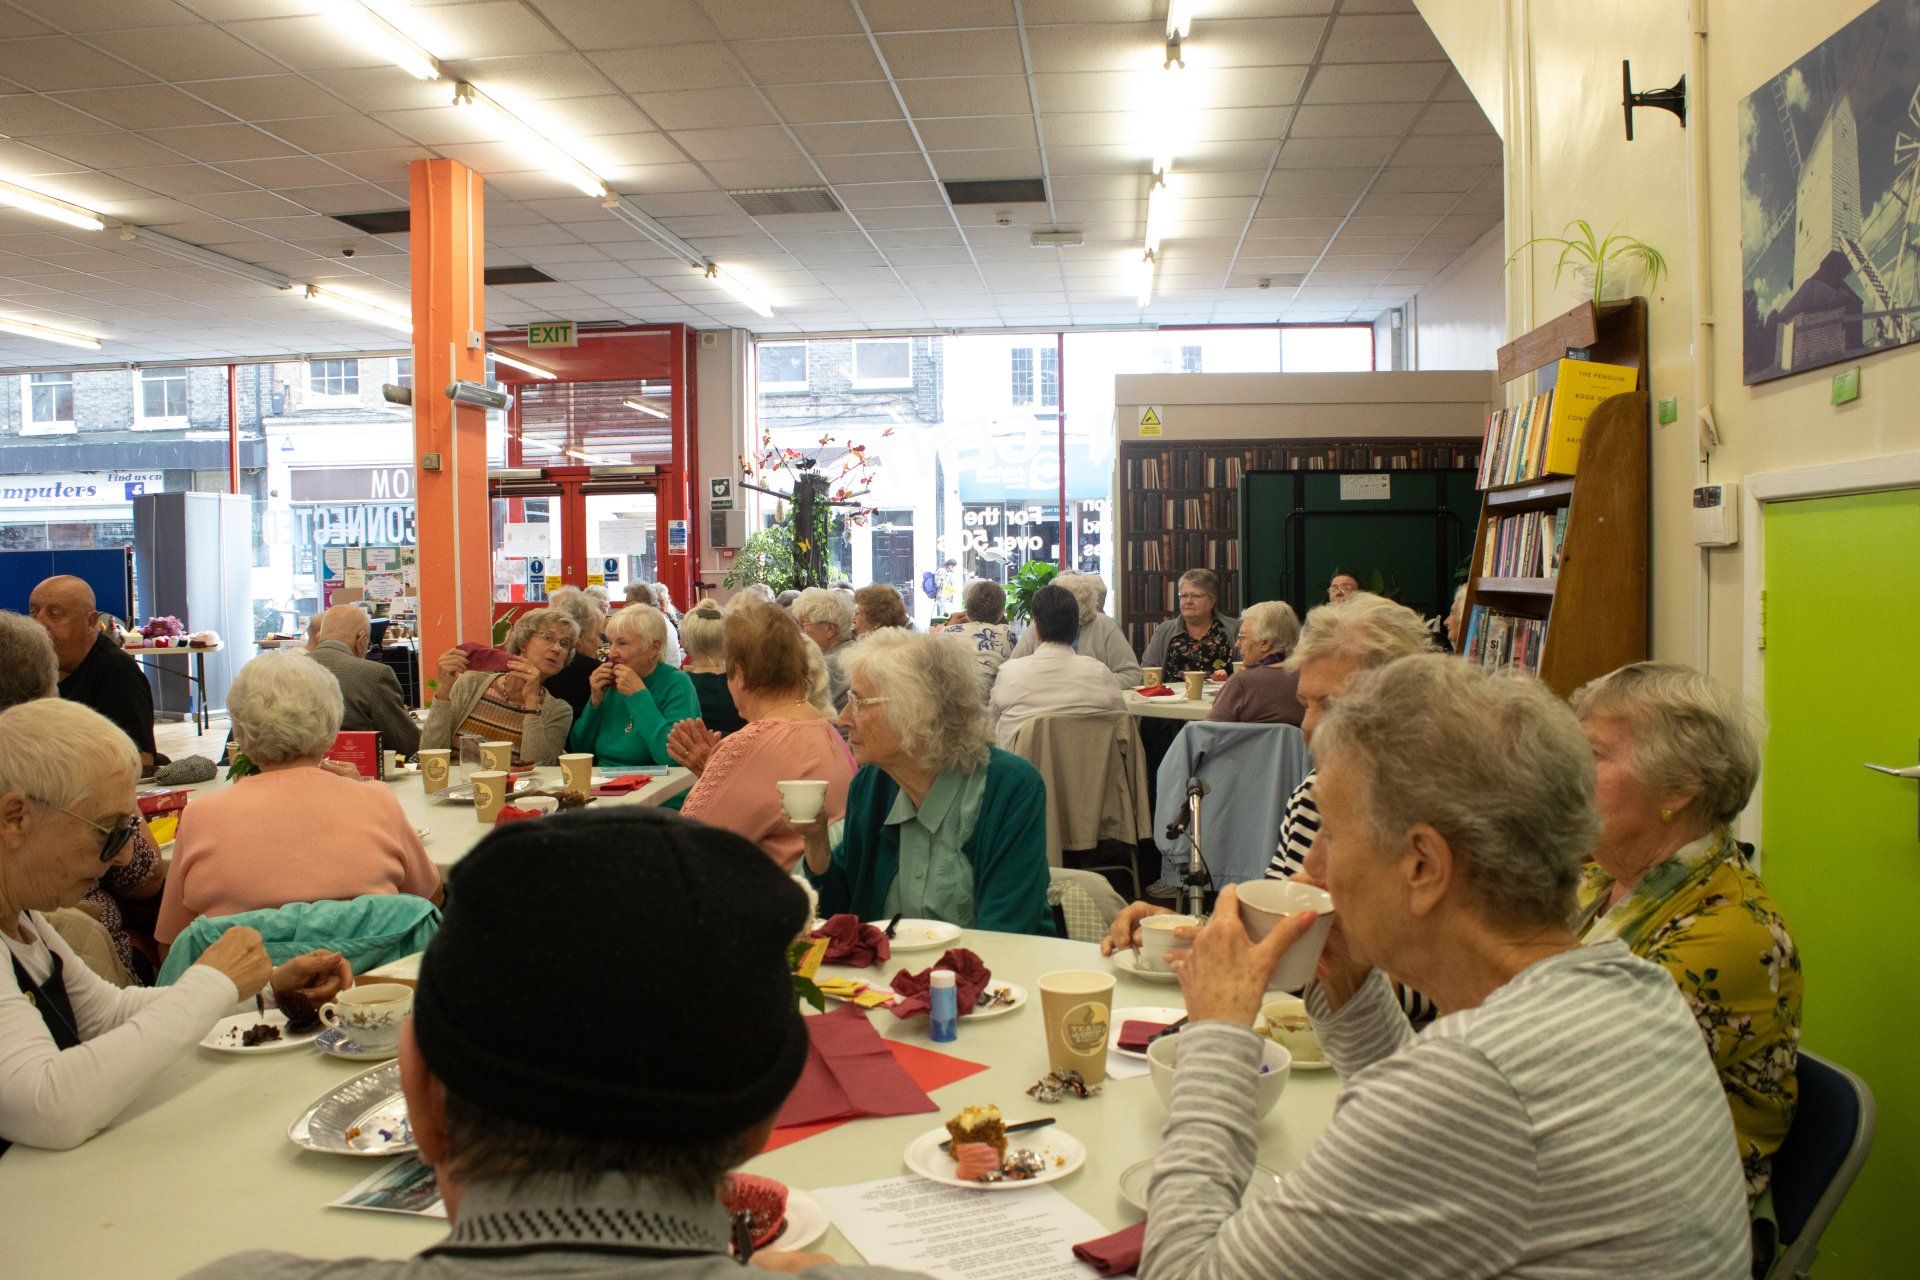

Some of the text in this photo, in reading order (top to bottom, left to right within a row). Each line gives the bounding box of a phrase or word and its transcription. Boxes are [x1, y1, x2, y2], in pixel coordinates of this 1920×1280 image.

[530, 326, 572, 343] EXIT
[1594, 373, 1625, 382] PENGUIN
[1575, 393, 1595, 401] BOOK
[0, 482, 97, 502] mputers
[371, 469, 415, 499] MO
